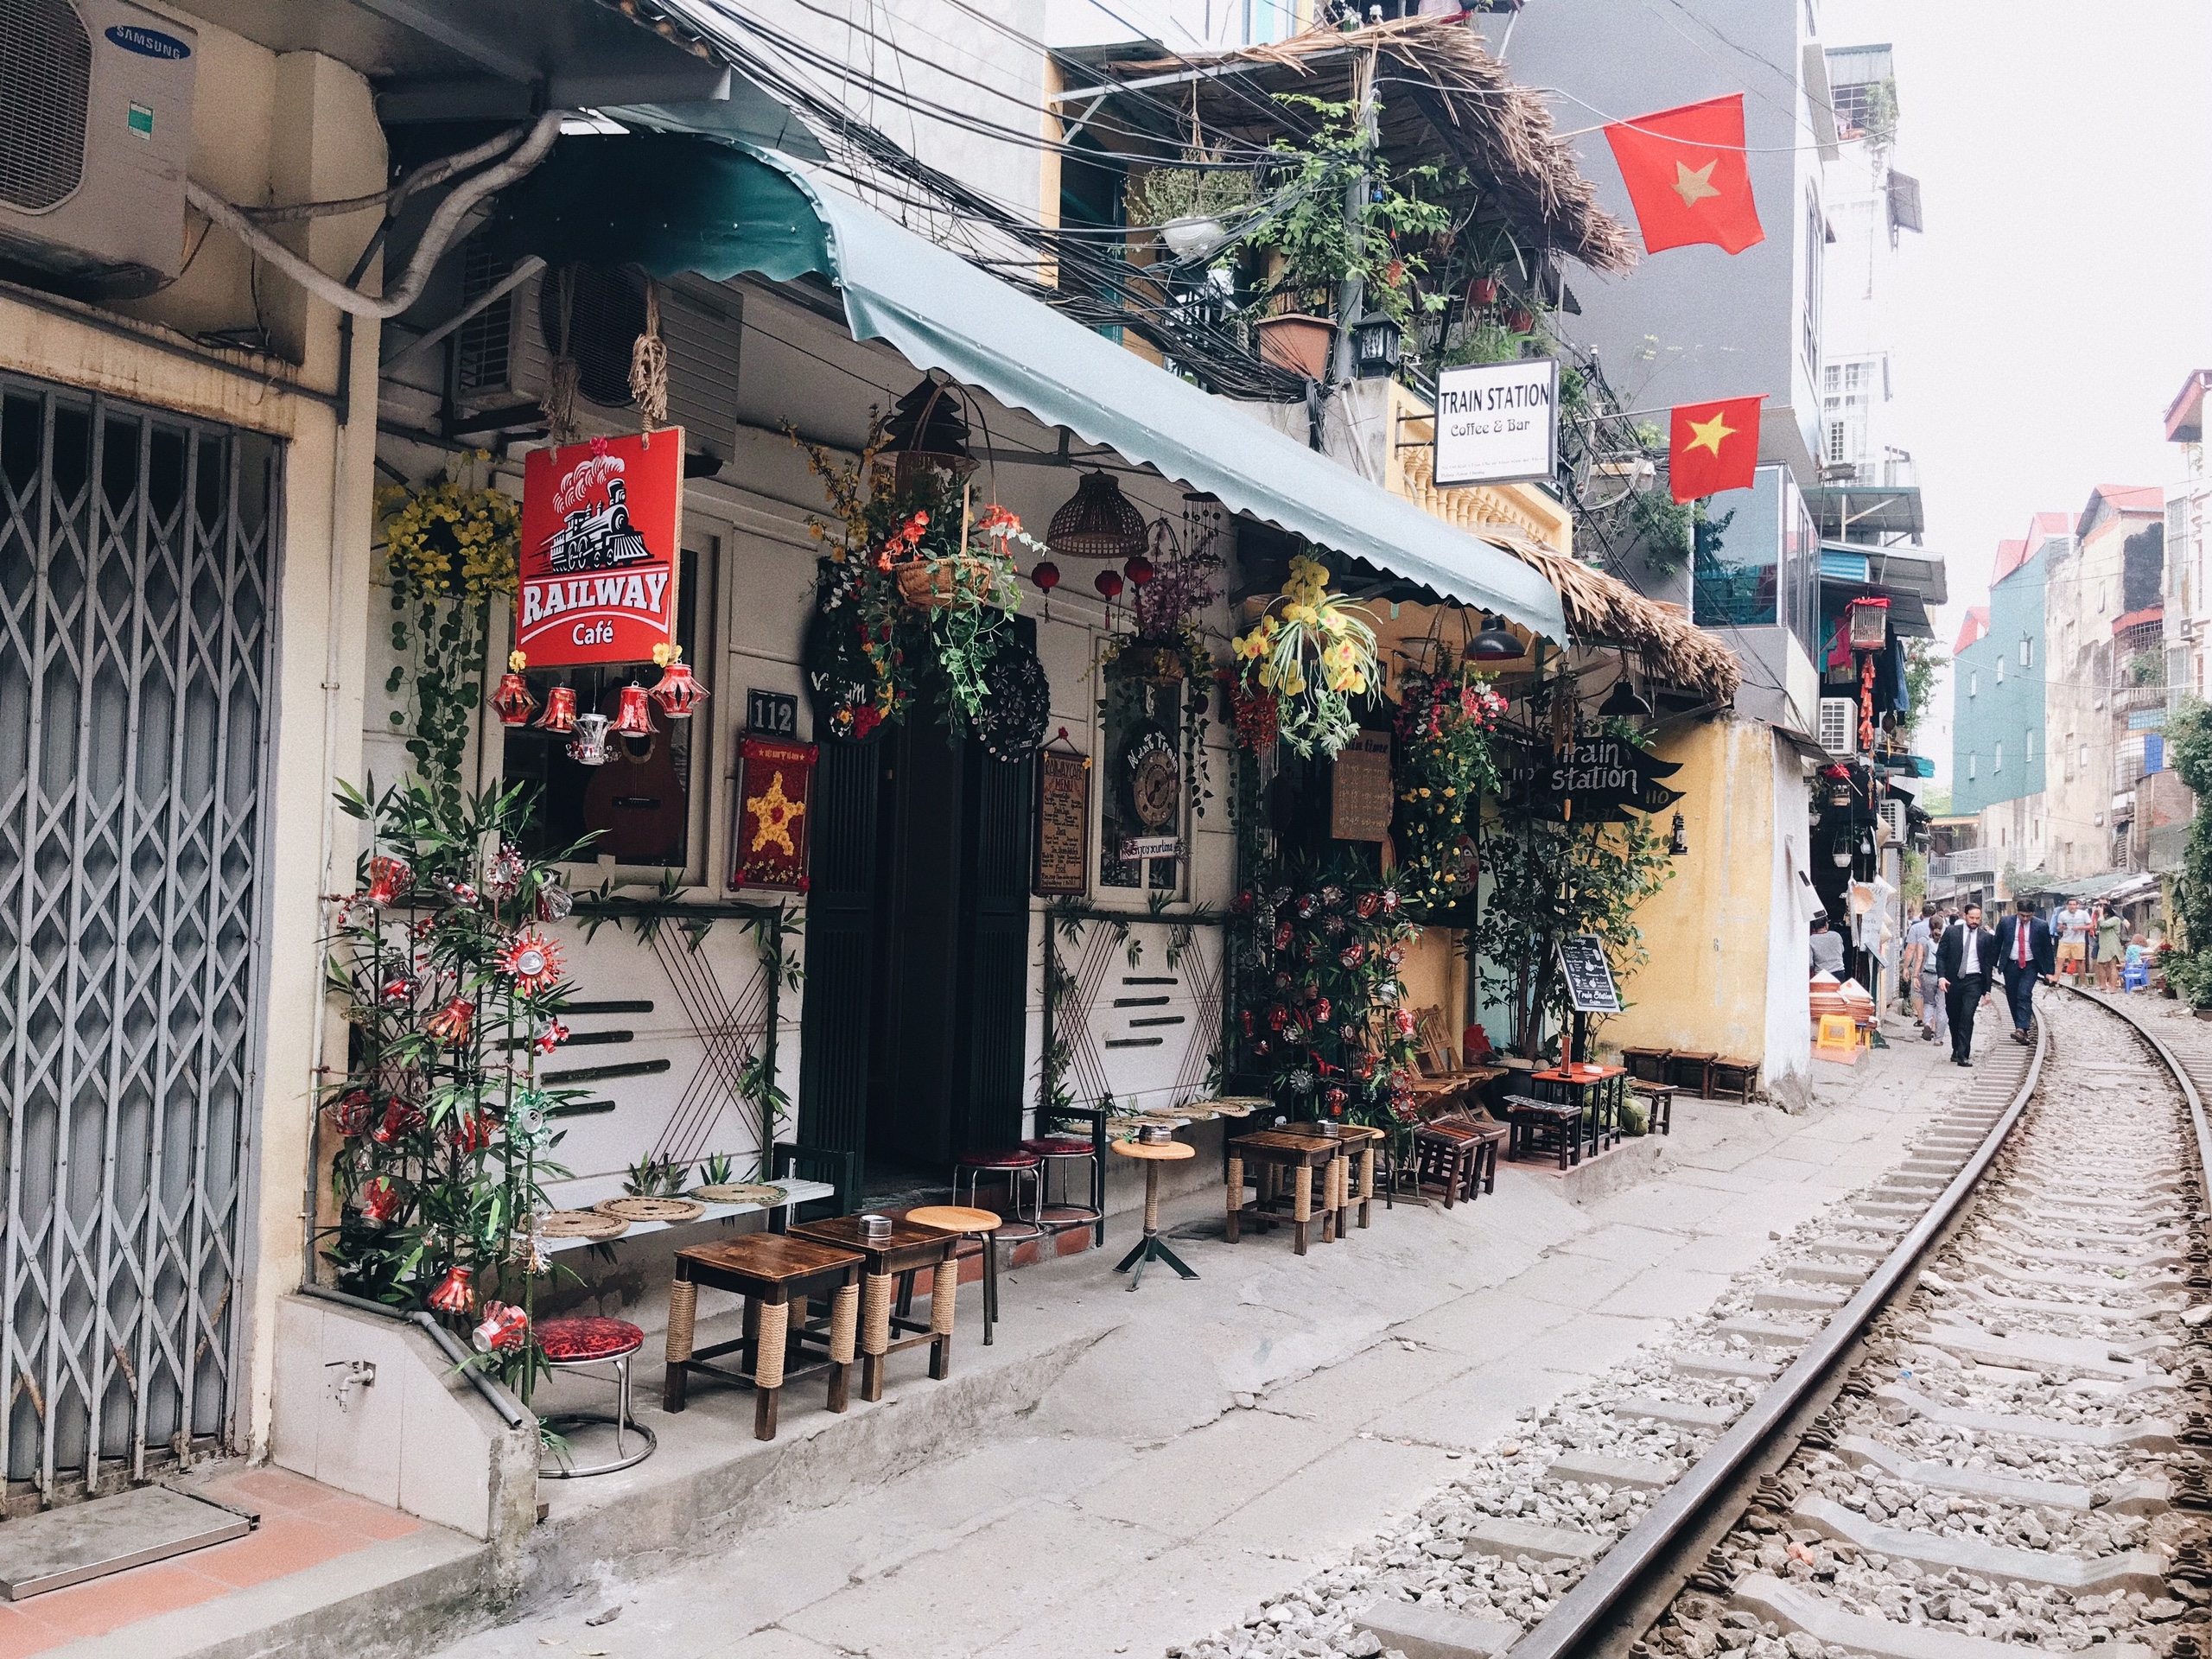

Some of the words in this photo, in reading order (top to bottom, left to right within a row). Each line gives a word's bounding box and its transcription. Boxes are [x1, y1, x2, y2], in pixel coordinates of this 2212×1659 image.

[116, 25, 181, 60] SAMSUNG
[1441, 389, 1483, 415] TRAIN
[1487, 383, 1549, 411] STATION
[1450, 423, 1490, 437] Coffee
[1493, 420, 1503, 433] &
[1507, 418, 1530, 432] Bar
[522, 572, 668, 628] RAILWAY
[572, 620, 614, 645] Café
[754, 699, 792, 732] 112
[1055, 779, 1073, 791] MENU
[1550, 766, 1639, 794] station
[1645, 790, 1670, 804] 110
